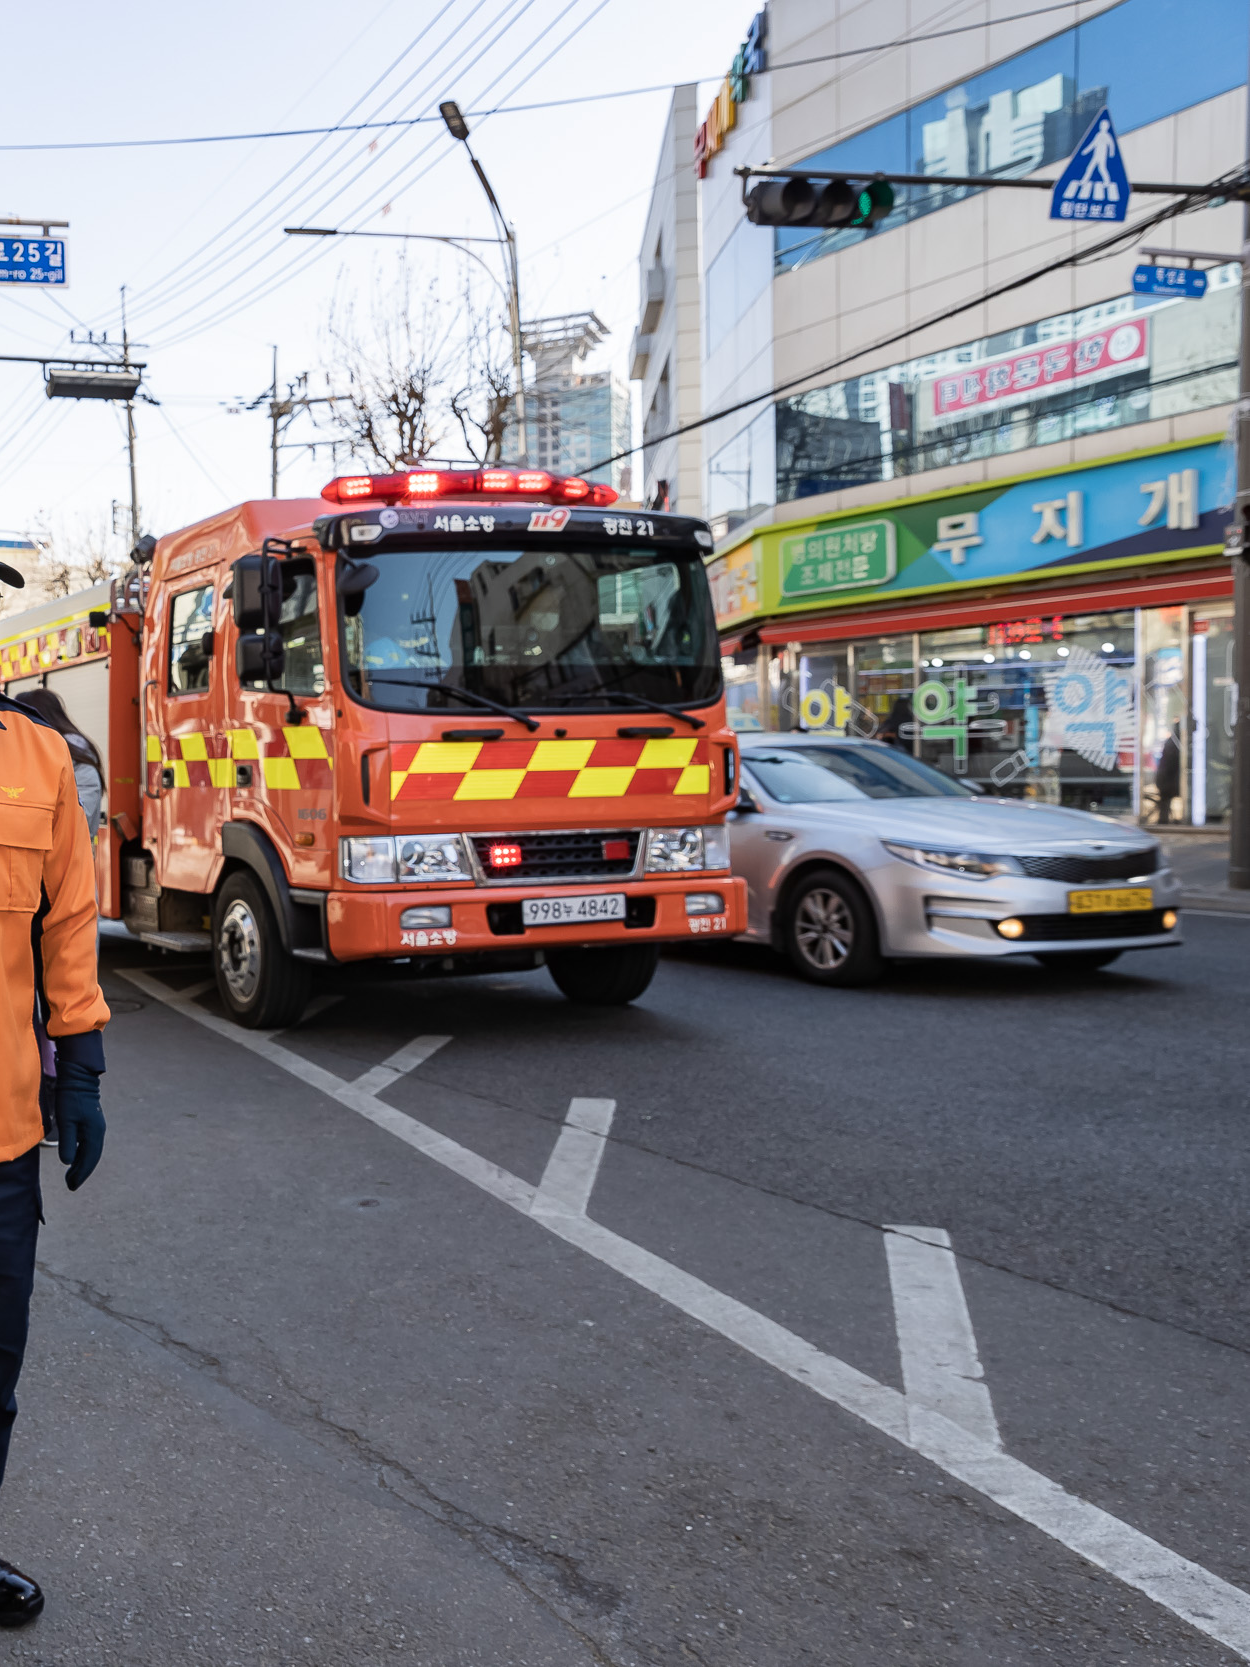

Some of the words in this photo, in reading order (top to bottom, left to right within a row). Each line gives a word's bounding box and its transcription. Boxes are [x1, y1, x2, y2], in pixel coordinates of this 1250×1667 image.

[30, 267, 63, 284] 25-gil
[433, 514, 496, 533] 서울소방
[531, 509, 568, 529] 119
[636, 518, 655, 537] 21
[913, 677, 978, 759] 약
[1054, 669, 1128, 755] 약
[578, 897, 620, 917] 4842
[713, 916, 727, 930] 21
[400, 929, 457, 948] 서울소방
